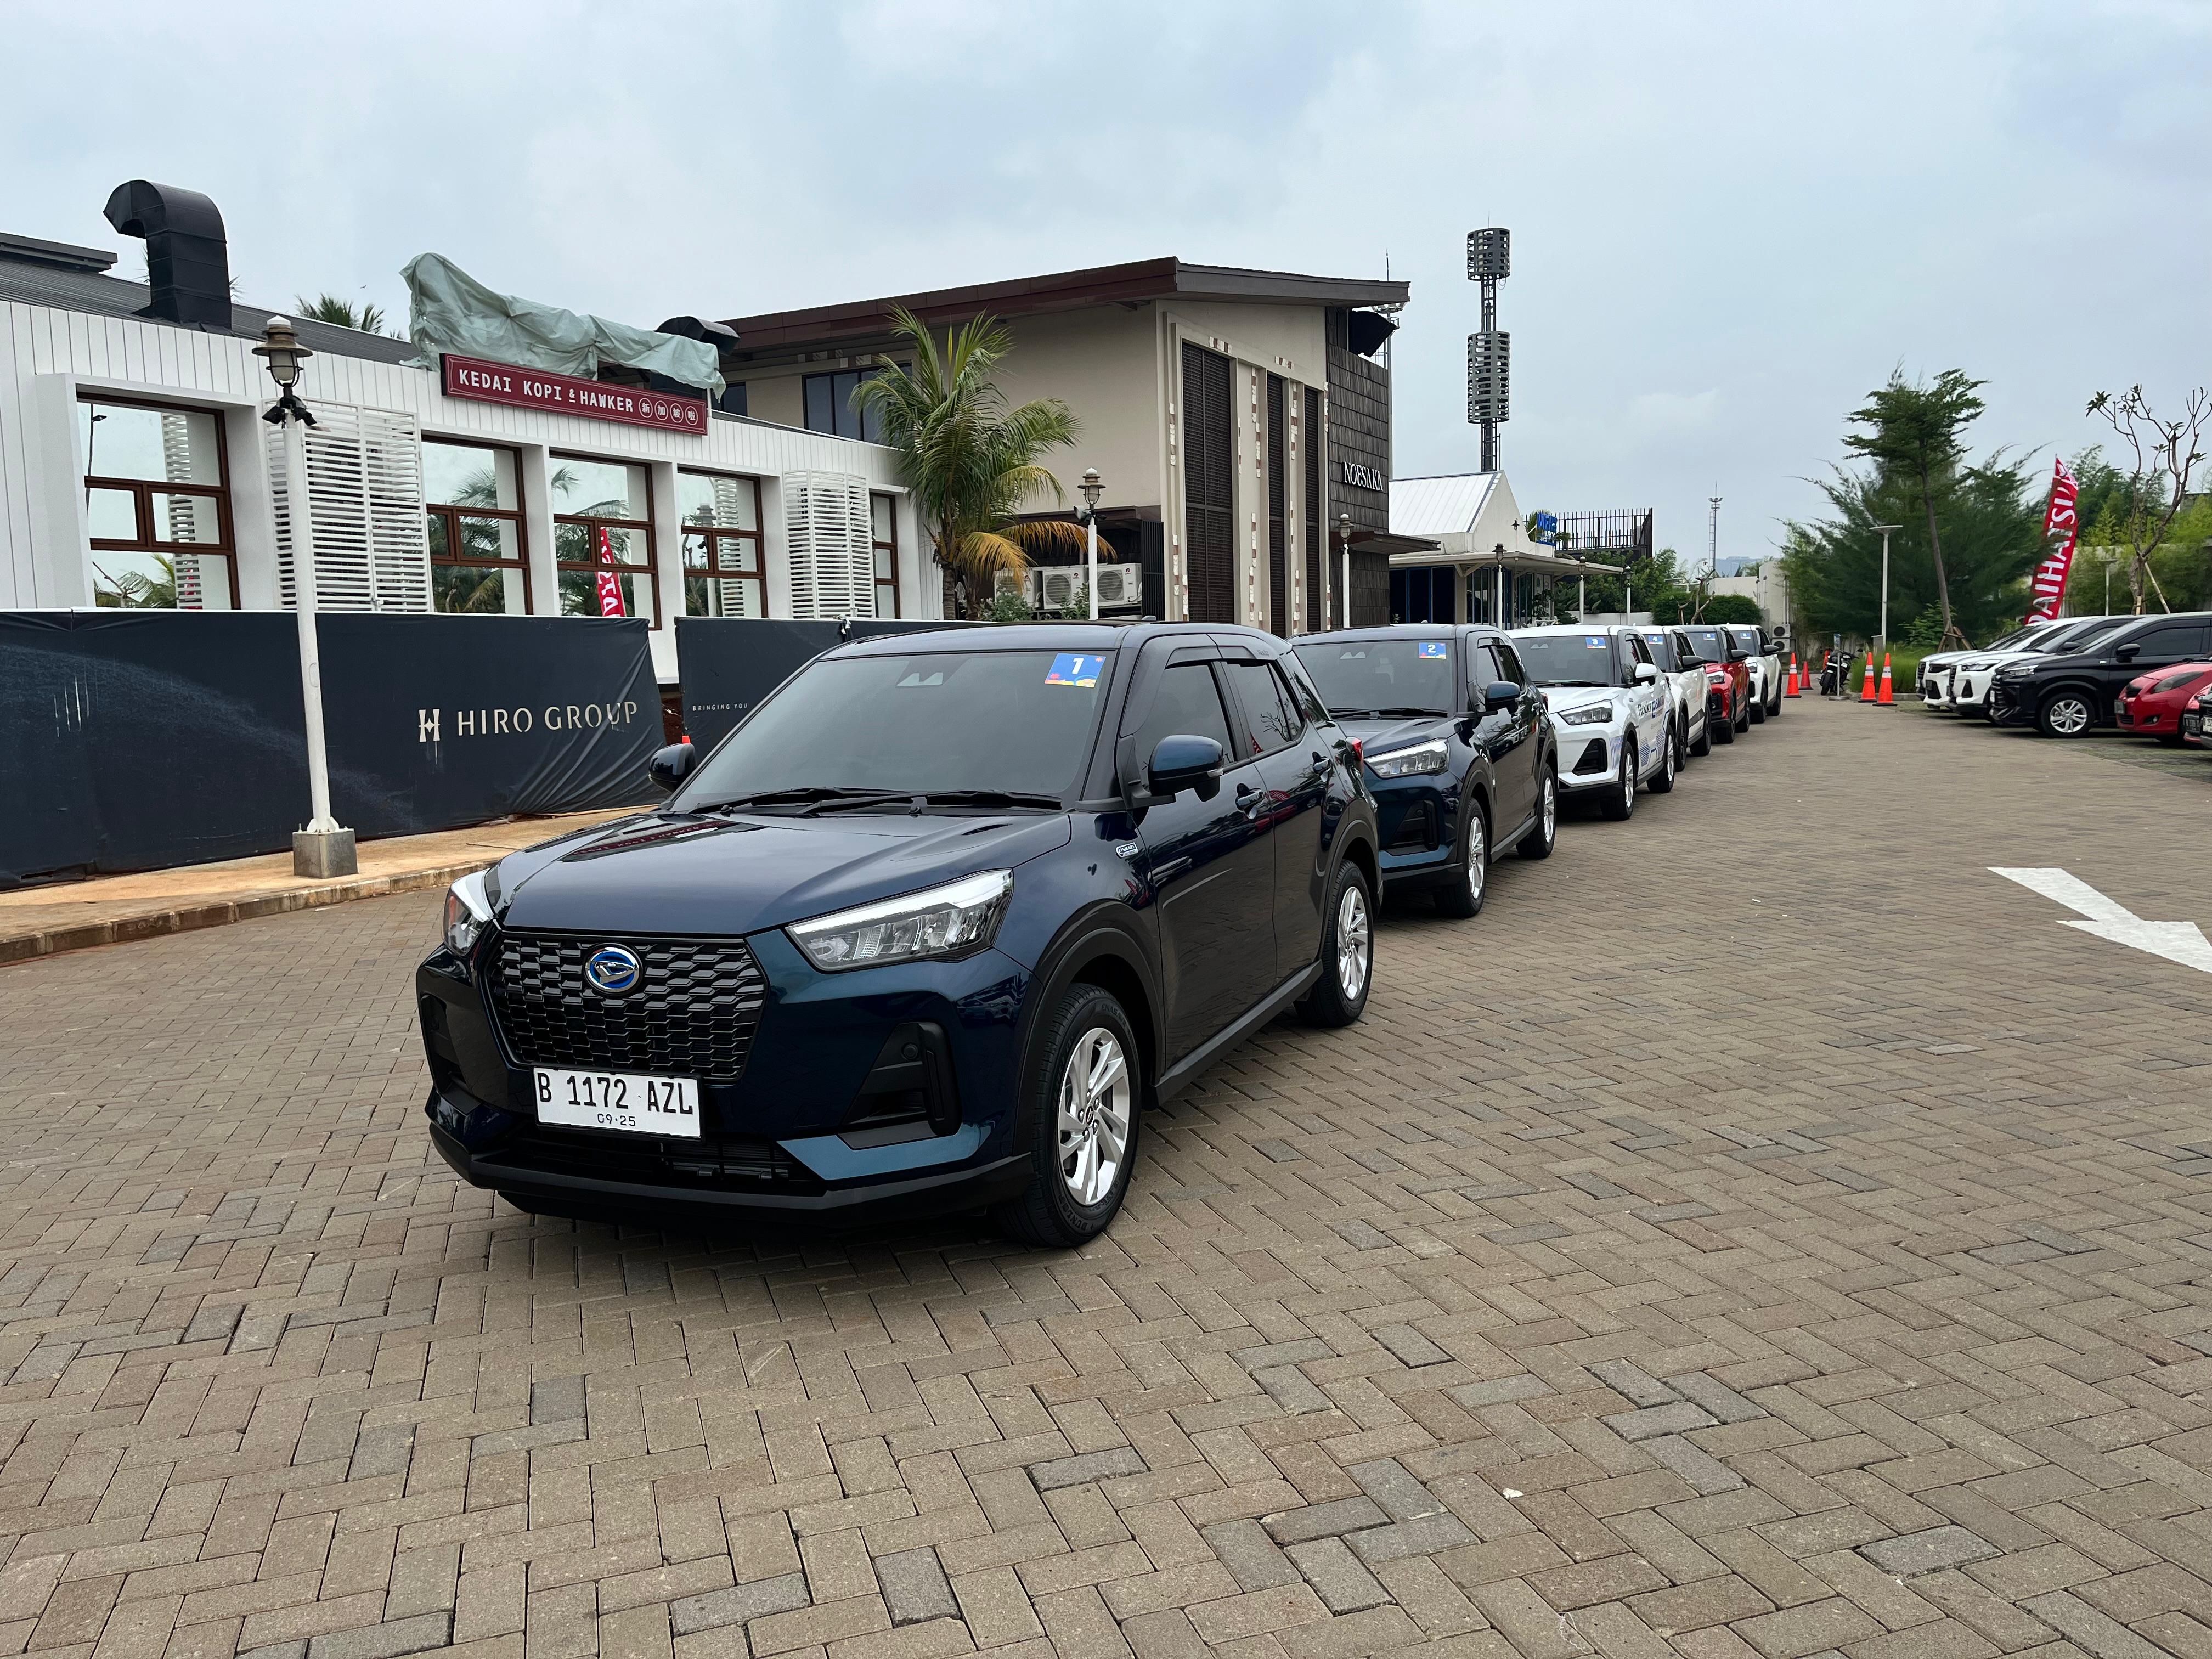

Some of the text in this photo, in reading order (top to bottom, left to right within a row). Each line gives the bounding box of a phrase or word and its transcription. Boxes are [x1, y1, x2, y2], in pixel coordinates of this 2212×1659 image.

[459, 369, 634, 413] KEDAI KOPI & HAWKER
[1344, 461, 1384, 492] NOESAKA
[1427, 644, 1436, 653] 2
[1071, 658, 1084, 674] 1
[458, 701, 637, 736] HIRO GROUP
[537, 1072, 693, 1115] B 1172 AZL
